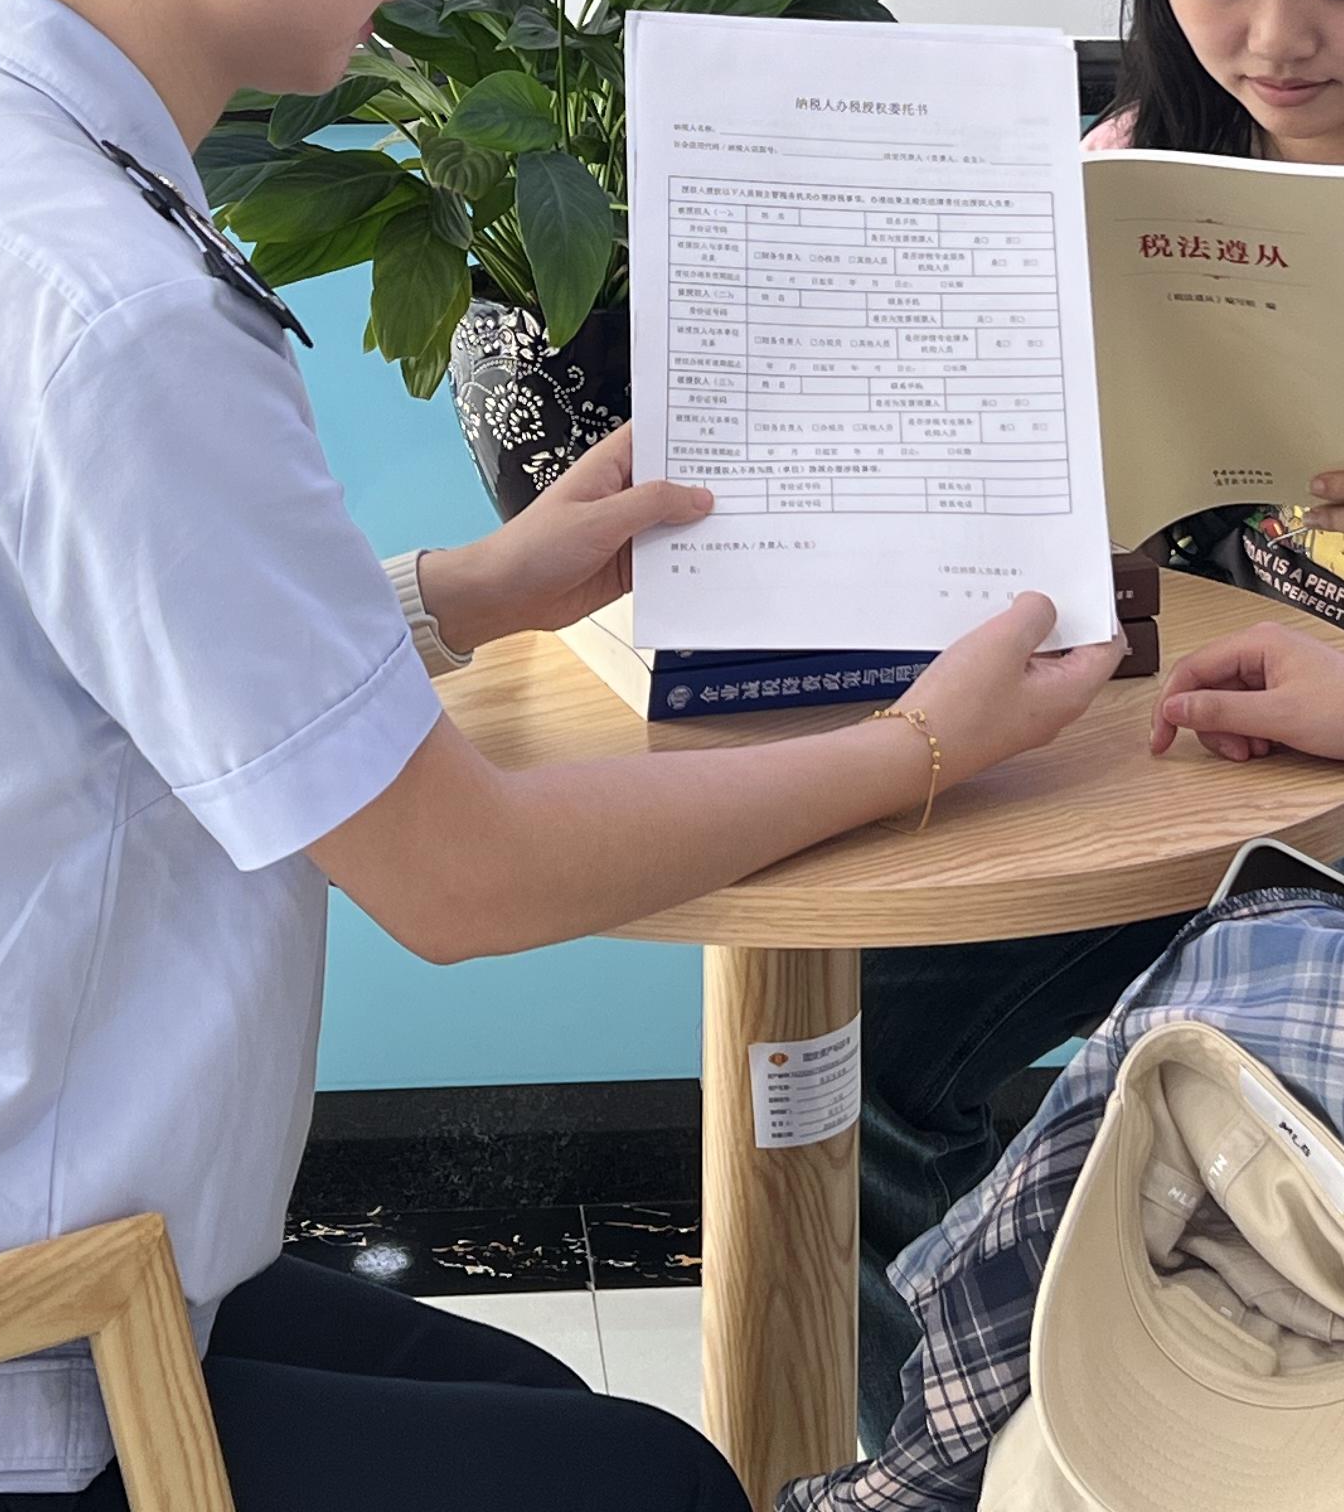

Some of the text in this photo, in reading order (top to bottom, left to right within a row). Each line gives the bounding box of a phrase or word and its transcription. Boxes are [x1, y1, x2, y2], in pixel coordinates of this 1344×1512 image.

[795, 96, 928, 117] 纳税人办税授权委托书
[1138, 234, 1289, 269] 税法遵从
[1272, 556, 1290, 575] IS
[1289, 568, 1303, 584] A
